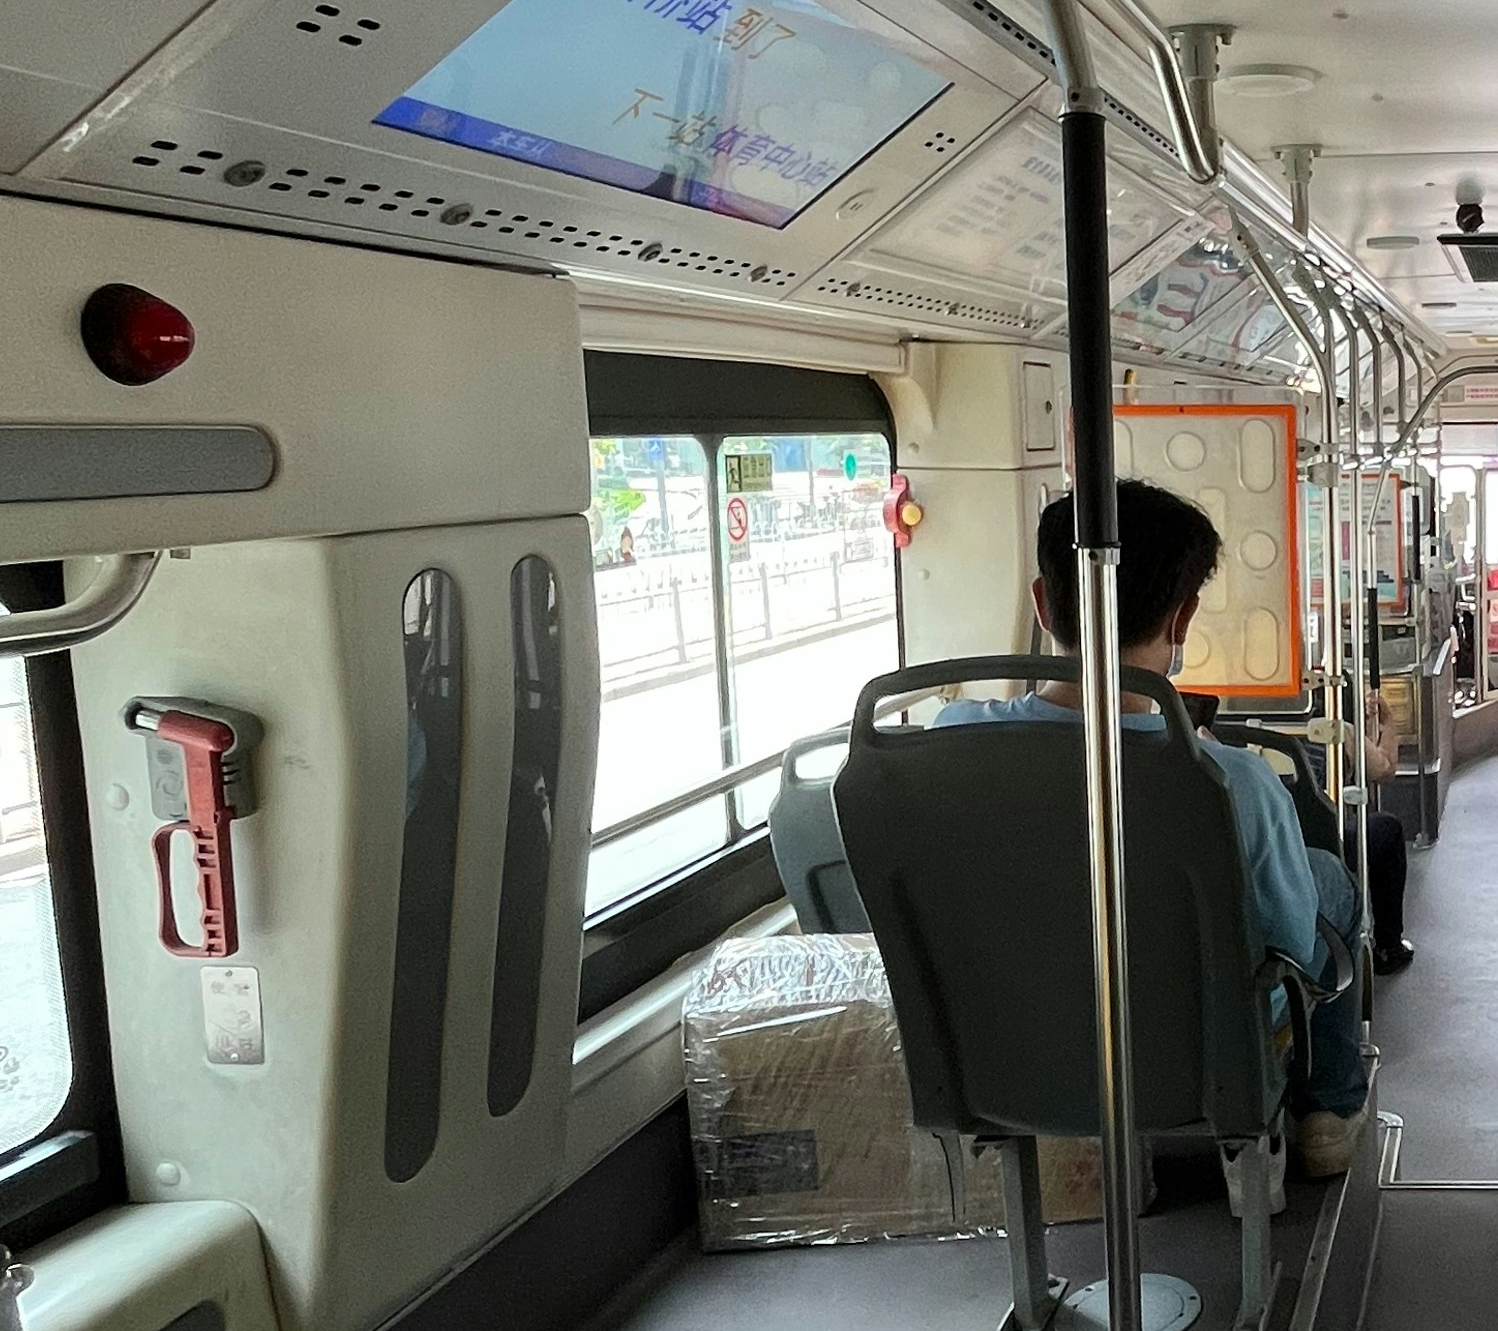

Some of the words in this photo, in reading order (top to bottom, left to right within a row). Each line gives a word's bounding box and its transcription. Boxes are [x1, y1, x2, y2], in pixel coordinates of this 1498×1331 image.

[713, 7, 796, 59] 到了
[612, 87, 718, 146] 下一站
[704, 125, 837, 186] 体育中心站
